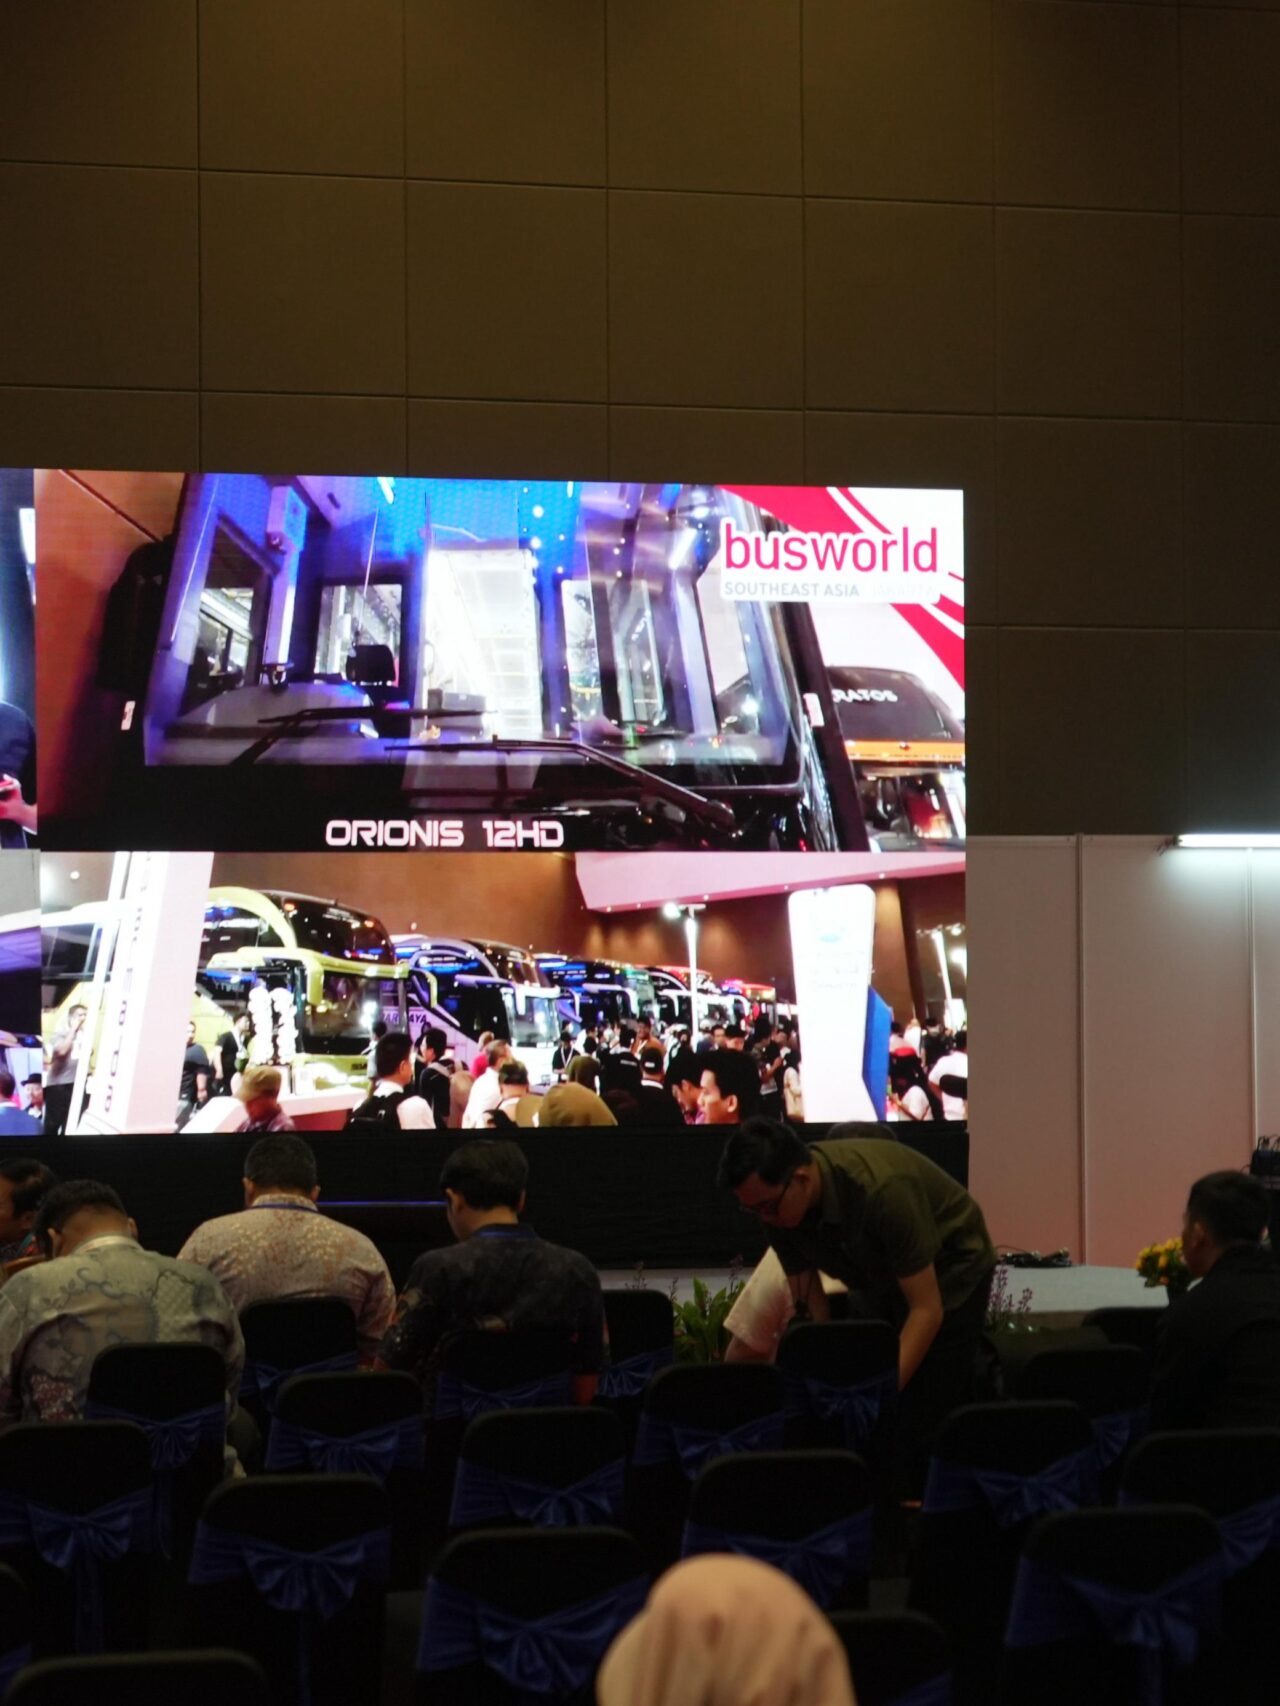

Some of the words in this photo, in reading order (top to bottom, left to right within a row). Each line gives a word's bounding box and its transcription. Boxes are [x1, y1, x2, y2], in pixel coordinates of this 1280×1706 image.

[725, 522, 938, 573] busworld
[724, 581, 821, 597] SOUTHEAST
[823, 583, 860, 598] ASIA
[325, 819, 465, 847] ORIONIS
[482, 820, 565, 848] 12HD
